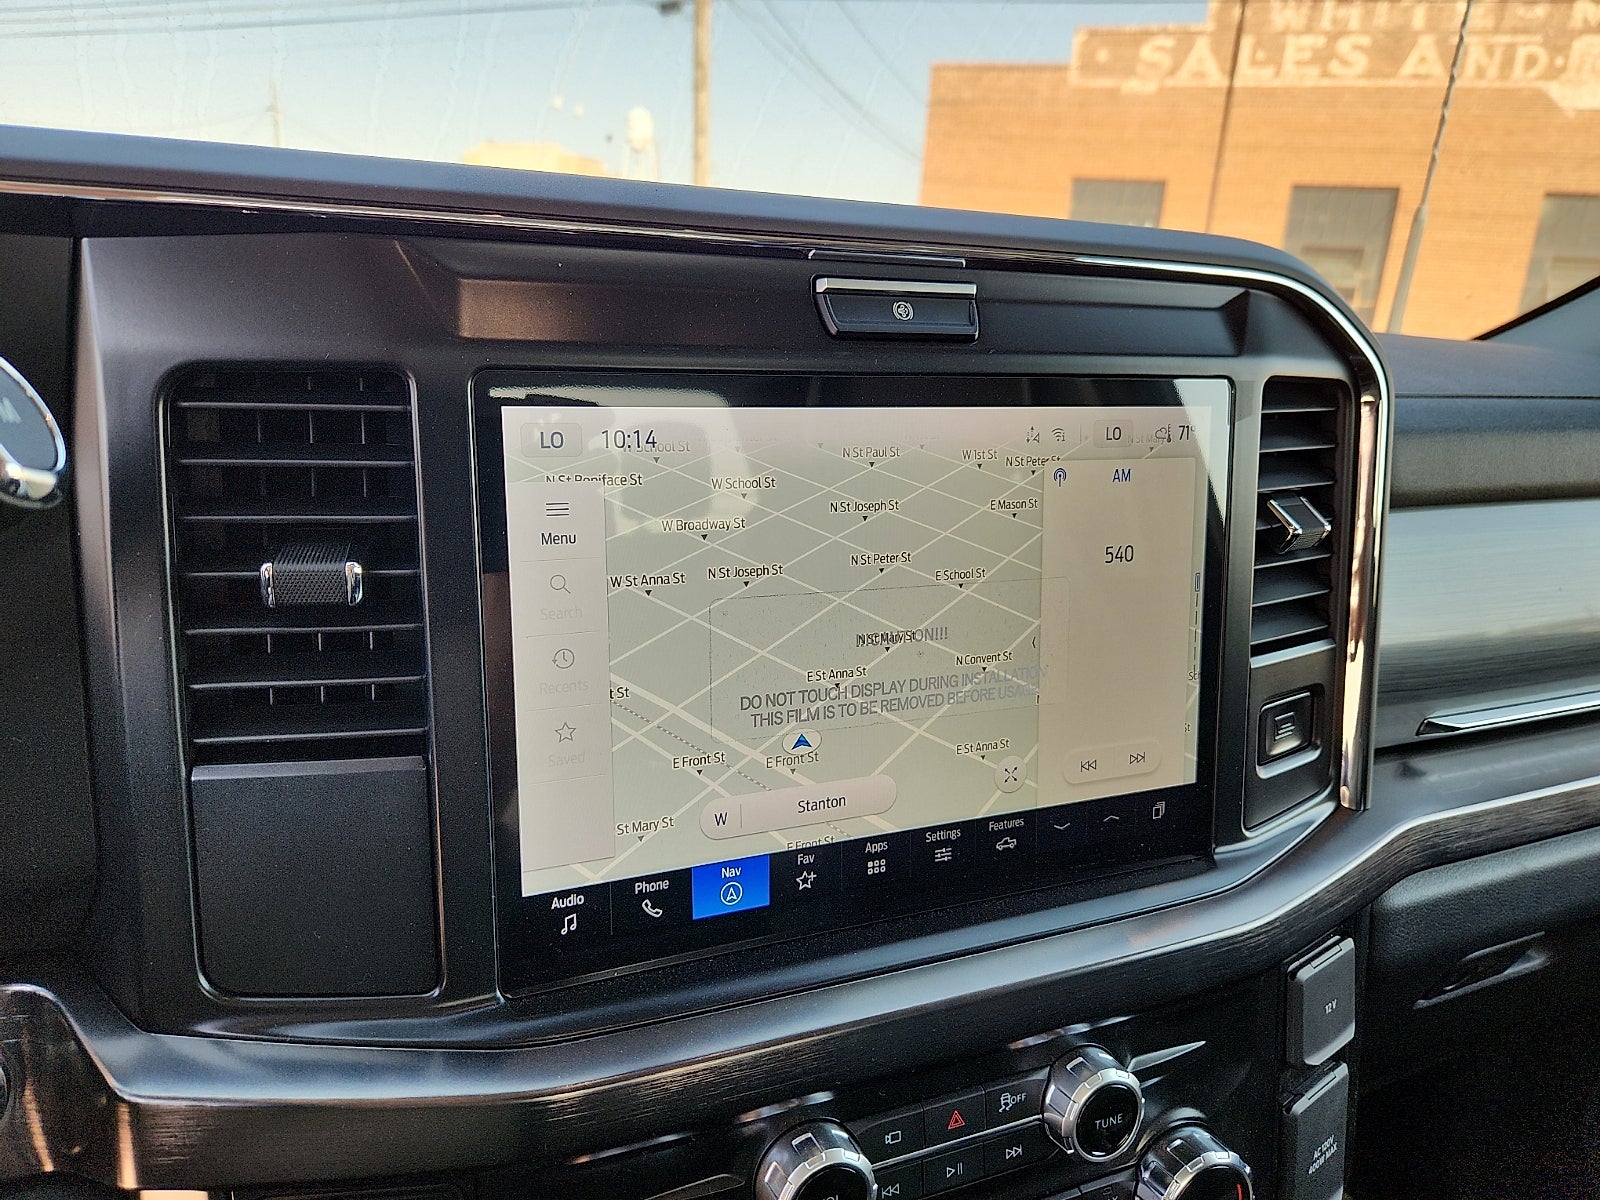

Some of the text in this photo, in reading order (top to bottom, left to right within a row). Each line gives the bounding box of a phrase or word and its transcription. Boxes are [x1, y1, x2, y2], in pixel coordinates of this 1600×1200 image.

[1136, 33, 1373, 80] SALES
[1397, 33, 1551, 80] AND
[540, 431, 564, 449] LO
[601, 429, 658, 449] 10:14
[1106, 426, 1122, 441] LO
[843, 446, 901, 458] N St Paul St
[962, 449, 998, 460] W 1st St
[1006, 456, 1013, 467] N
[1014, 456, 1025, 467] St
[629, 473, 643, 486] St
[711, 476, 776, 489] W School St
[1112, 468, 1131, 482] AM
[830, 500, 900, 513] N St Joseph St
[990, 498, 1038, 510] E Mason St
[661, 517, 746, 532] W Broadway St
[541, 532, 577, 546] Menu
[851, 552, 911, 565] N St Peter St
[1104, 544, 1134, 564] 540
[708, 564, 784, 579] N St Joseph St
[935, 568, 986, 581] E School St
[610, 572, 686, 587] W St Anna St
[540, 606, 583, 621] Search
[956, 651, 1013, 666] N Convent St
[807, 667, 867, 682] E St Anna St
[539, 679, 589, 696] Recents
[616, 686, 630, 699] St
[740, 665, 1047, 711] DO NOT TOUCH DISPLAY DURING INSTALLATION
[751, 712, 784, 728] THIS
[786, 707, 820, 724] FILM
[823, 705, 835, 720] IS
[838, 703, 857, 718] TO
[860, 700, 878, 716] BE
[880, 693, 944, 713] REMOVED
[947, 687, 996, 706] BEFORE
[957, 739, 1009, 755] E St Anna St
[547, 751, 586, 768] Saved
[673, 751, 725, 769] E Front St
[766, 751, 819, 769] E Front St
[797, 796, 847, 814] Stanton
[616, 816, 674, 836] St Mary St
[714, 811, 728, 827] W
[988, 817, 1025, 832] Features
[925, 827, 961, 844] Settings
[865, 840, 888, 855] Apps
[797, 853, 815, 866] Fav
[721, 866, 742, 879] Nav
[634, 879, 670, 895] Phone
[551, 893, 585, 910] Audio
[1324, 998, 1337, 1014] 12V
[1010, 1092, 1027, 1105] OFF
[1094, 1113, 1124, 1130] TUNE
